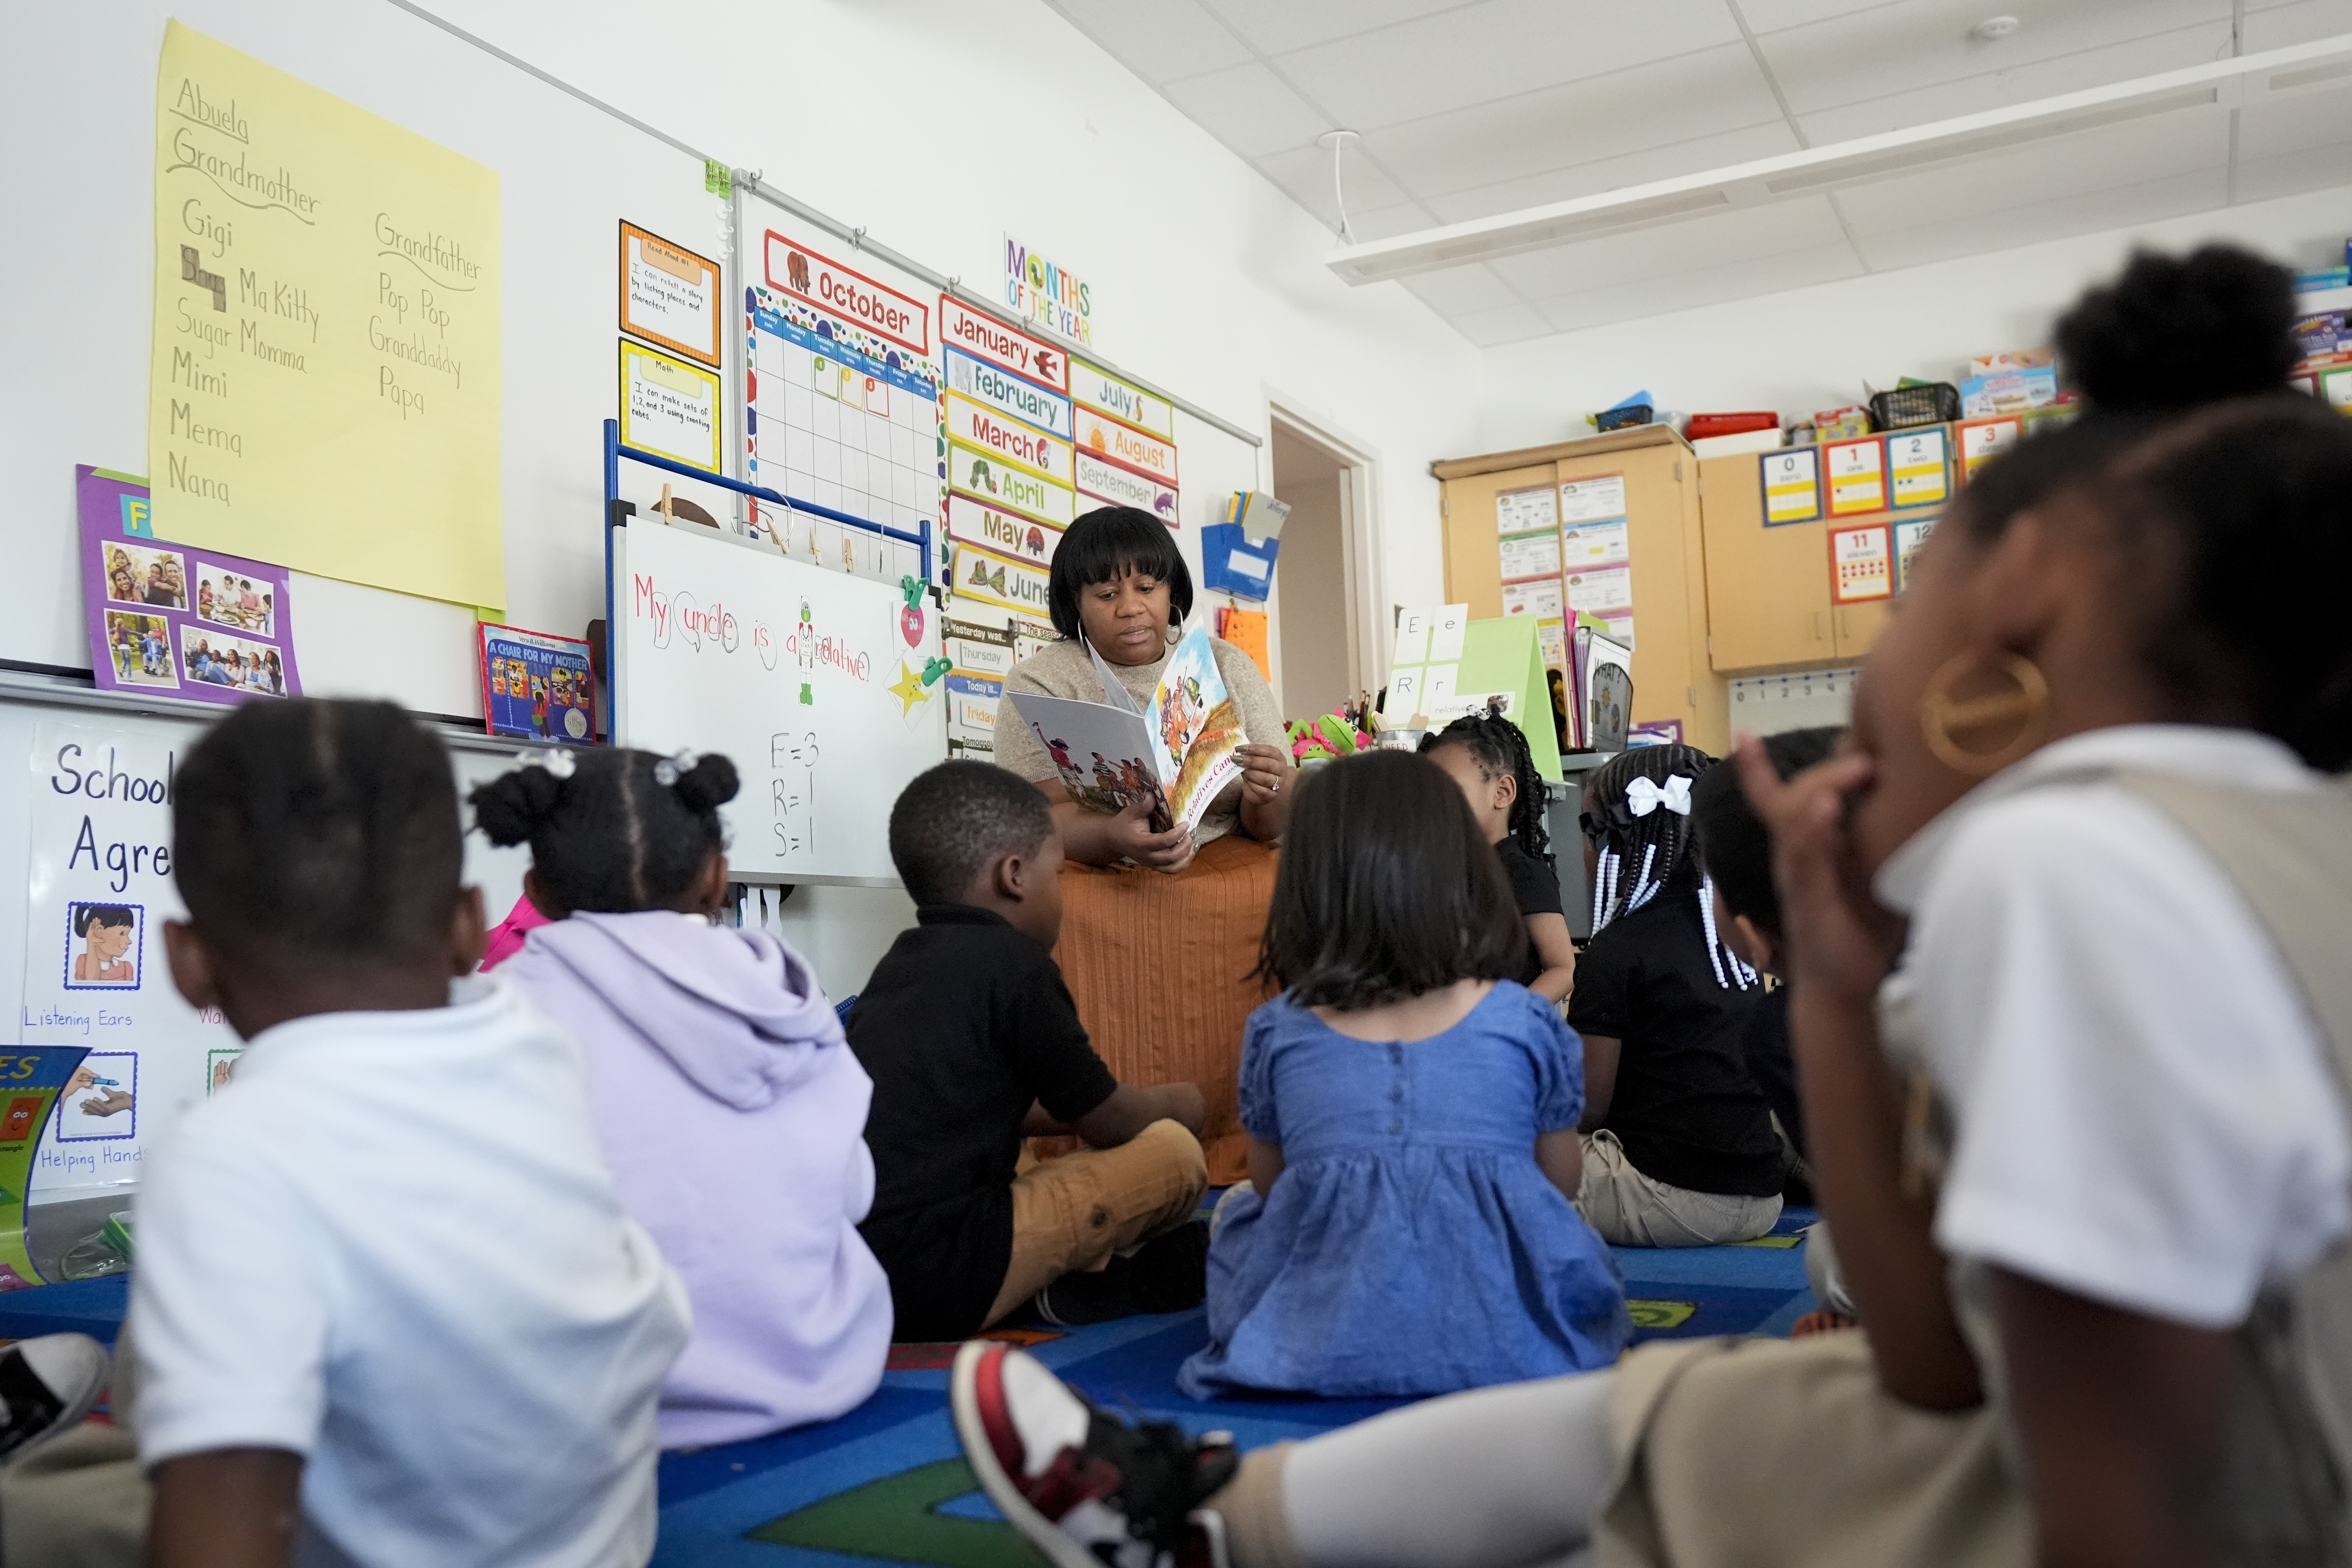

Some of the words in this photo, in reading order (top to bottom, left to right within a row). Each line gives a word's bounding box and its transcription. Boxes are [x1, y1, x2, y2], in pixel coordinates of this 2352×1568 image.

[176, 78, 249, 140] Abuela
[173, 127, 321, 213] Grandmother
[182, 198, 232, 258] Gigi
[375, 212, 482, 280] Grandfather
[648, 242, 662, 254] Read
[664, 250, 679, 262] Aloud
[632, 263, 639, 274] I
[645, 270, 657, 281] can
[661, 278, 678, 290] retell
[689, 290, 702, 303] story
[632, 276, 639, 289] by
[645, 282, 664, 300] listing
[667, 292, 685, 306] places
[1008, 239, 1090, 317] MONTHS
[379, 272, 408, 324] Pop
[421, 289, 450, 338] Pop
[632, 292, 668, 314] characters.
[820, 272, 910, 334] October
[1009, 279, 1024, 309] OF
[1030, 290, 1053, 326] THE
[1058, 306, 1091, 347] YEAR
[176, 297, 232, 359] Sugar
[240, 318, 308, 374] Momma
[368, 316, 461, 389] Granddaddy
[759, 310, 778, 324] Sunday
[786, 322, 806, 337] Monday
[814, 334, 834, 348] Tuesday
[840, 346, 861, 361] Wednesday
[866, 358, 885, 370] Thursday
[893, 368, 907, 379] Friday
[914, 377, 932, 390] Saturday
[954, 312, 1028, 370] January
[172, 346, 227, 398] Mimi
[656, 360, 673, 374] Math
[380, 365, 425, 420] Papa
[635, 382, 642, 393] I
[648, 388, 658, 397] can
[662, 395, 680, 406] make
[684, 403, 697, 412] sets
[975, 365, 1058, 428] February
[1100, 381, 1131, 418] July
[170, 398, 242, 458] Mema
[632, 408, 652, 421] cubes.
[646, 401, 657, 410] and
[661, 404, 664, 412] 3
[668, 409, 683, 424] using
[686, 416, 710, 432] counting
[973, 413, 1034, 461] March
[1115, 431, 1165, 470] August
[1784, 458, 1795, 471] 0
[1850, 448, 1858, 461] 1
[1911, 438, 1921, 452] 2
[1985, 427, 1995, 442] 3
[168, 451, 230, 506] Nana
[1002, 473, 1045, 510] April
[1080, 461, 1151, 504] September
[984, 510, 1024, 552] May
[1852, 534, 1868, 548] 11
[535, 639, 556, 648] Williams
[635, 573, 667, 637] My
[683, 603, 733, 640] uncle
[754, 620, 769, 648] is
[786, 635, 797, 655] a
[815, 636, 869, 683] relative.
[952, 622, 985, 641] Yesterday
[987, 631, 1007, 642] was...
[1026, 624, 1038, 636] The
[1408, 616, 1419, 633] E
[1445, 618, 1455, 629] e
[490, 642, 497, 653] A
[498, 643, 522, 659] CHAIR
[523, 649, 538, 662] FOR
[541, 653, 554, 664] MY
[555, 655, 587, 670] MOTHER
[963, 646, 1001, 665] Thursday
[967, 680, 986, 692] Today
[987, 685, 998, 694] is...
[1397, 677, 1412, 693] R
[1436, 680, 1443, 691] r
[51, 744, 173, 806] School
[1187, 775, 1213, 821] Relatives
[24, 1004, 91, 1035] Listening
[98, 1010, 133, 1026] Ears
[41, 1149, 95, 1174] Helping
